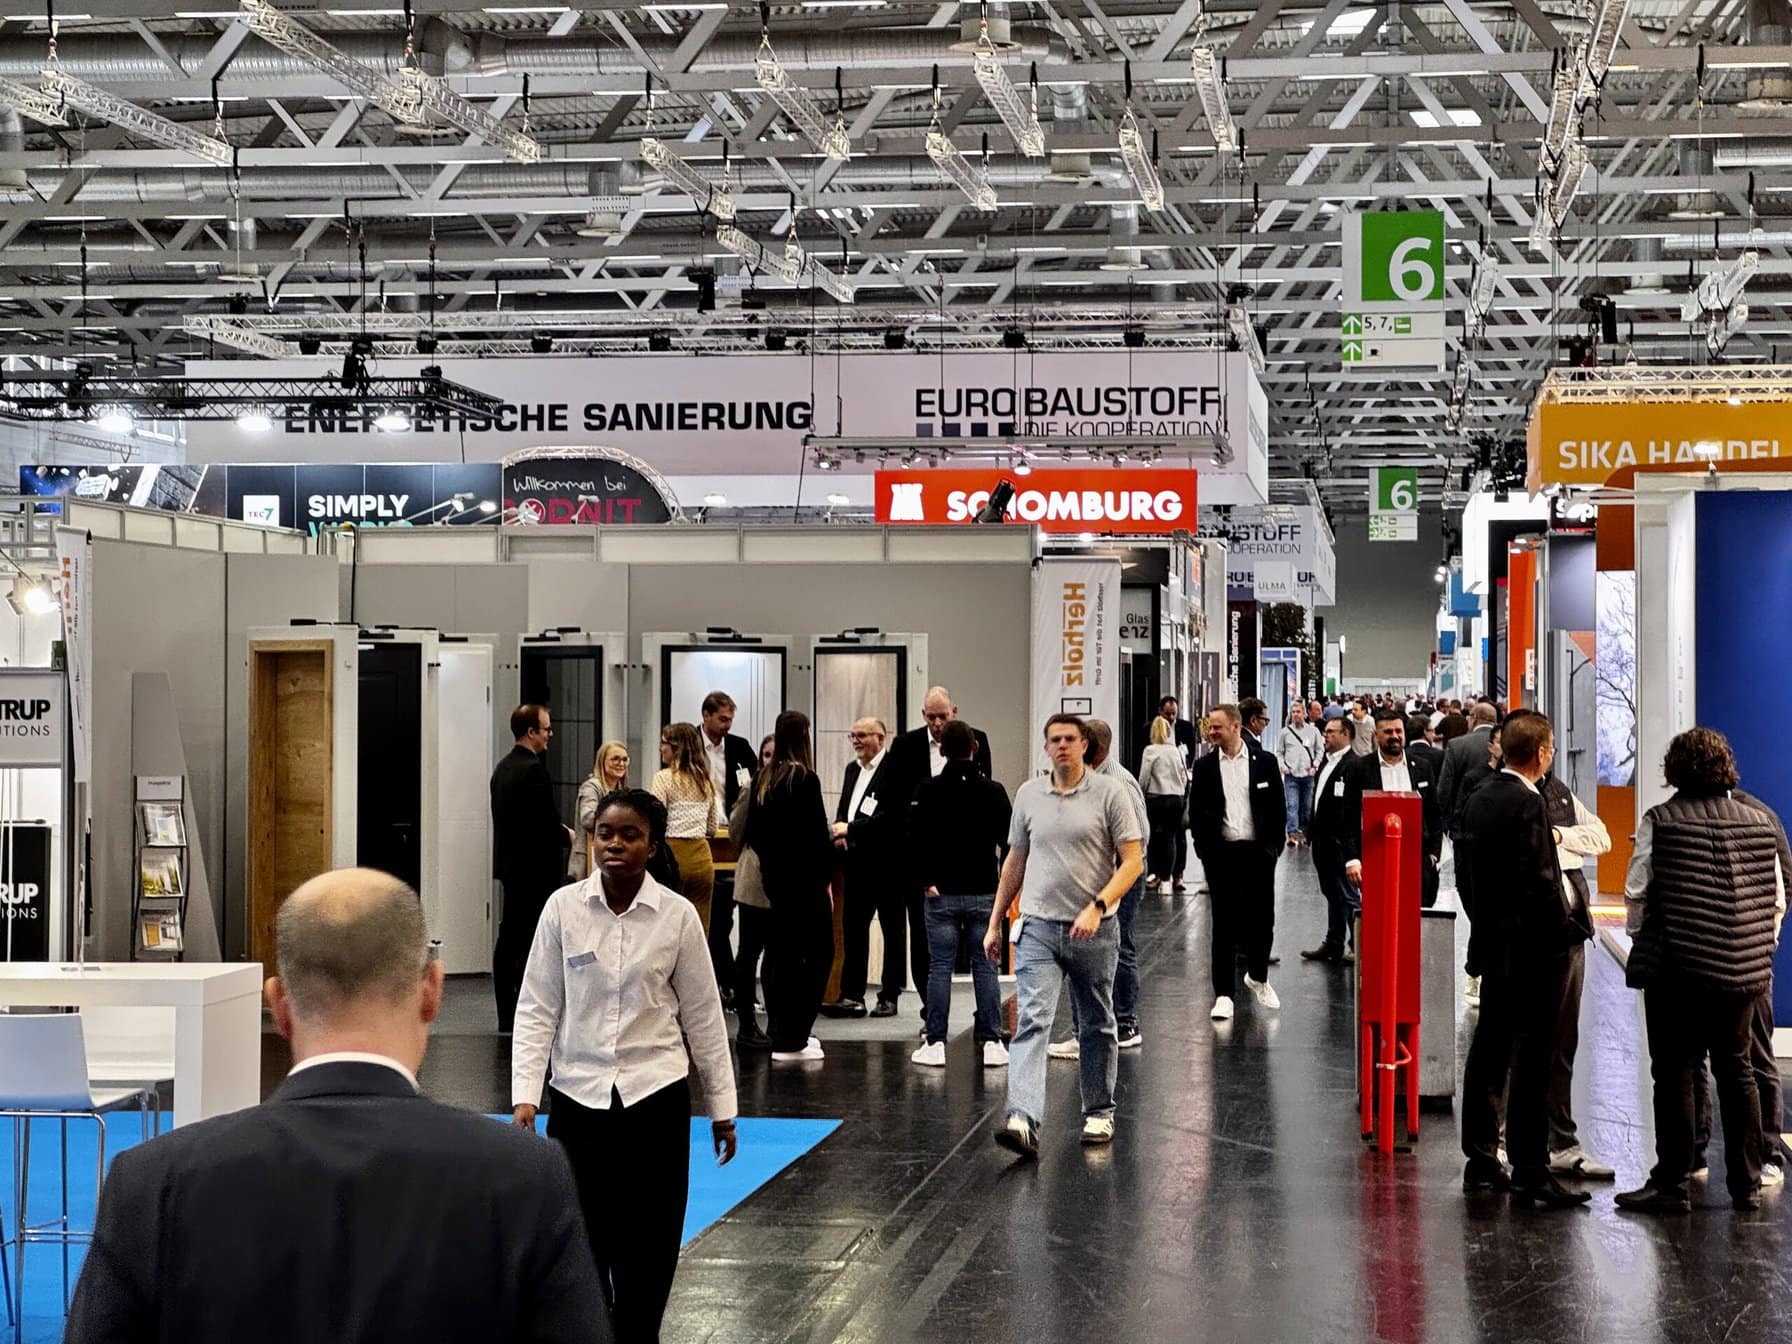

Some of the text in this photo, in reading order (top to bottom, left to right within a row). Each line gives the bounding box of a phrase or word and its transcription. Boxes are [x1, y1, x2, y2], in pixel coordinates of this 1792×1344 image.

[1389, 237, 1435, 301] 6
[1364, 316, 1392, 331] 5, 7,
[583, 402, 812, 431] SANIERUNG
[1559, 441, 1638, 469] SIKA
[513, 475, 628, 493] Willkommen bei
[1391, 480, 1413, 511] 6
[308, 495, 409, 517] SIMPLY
[1258, 581, 1287, 591] ULMA
[1126, 613, 1149, 624] Glas
[0, 725, 50, 736] TIONS
